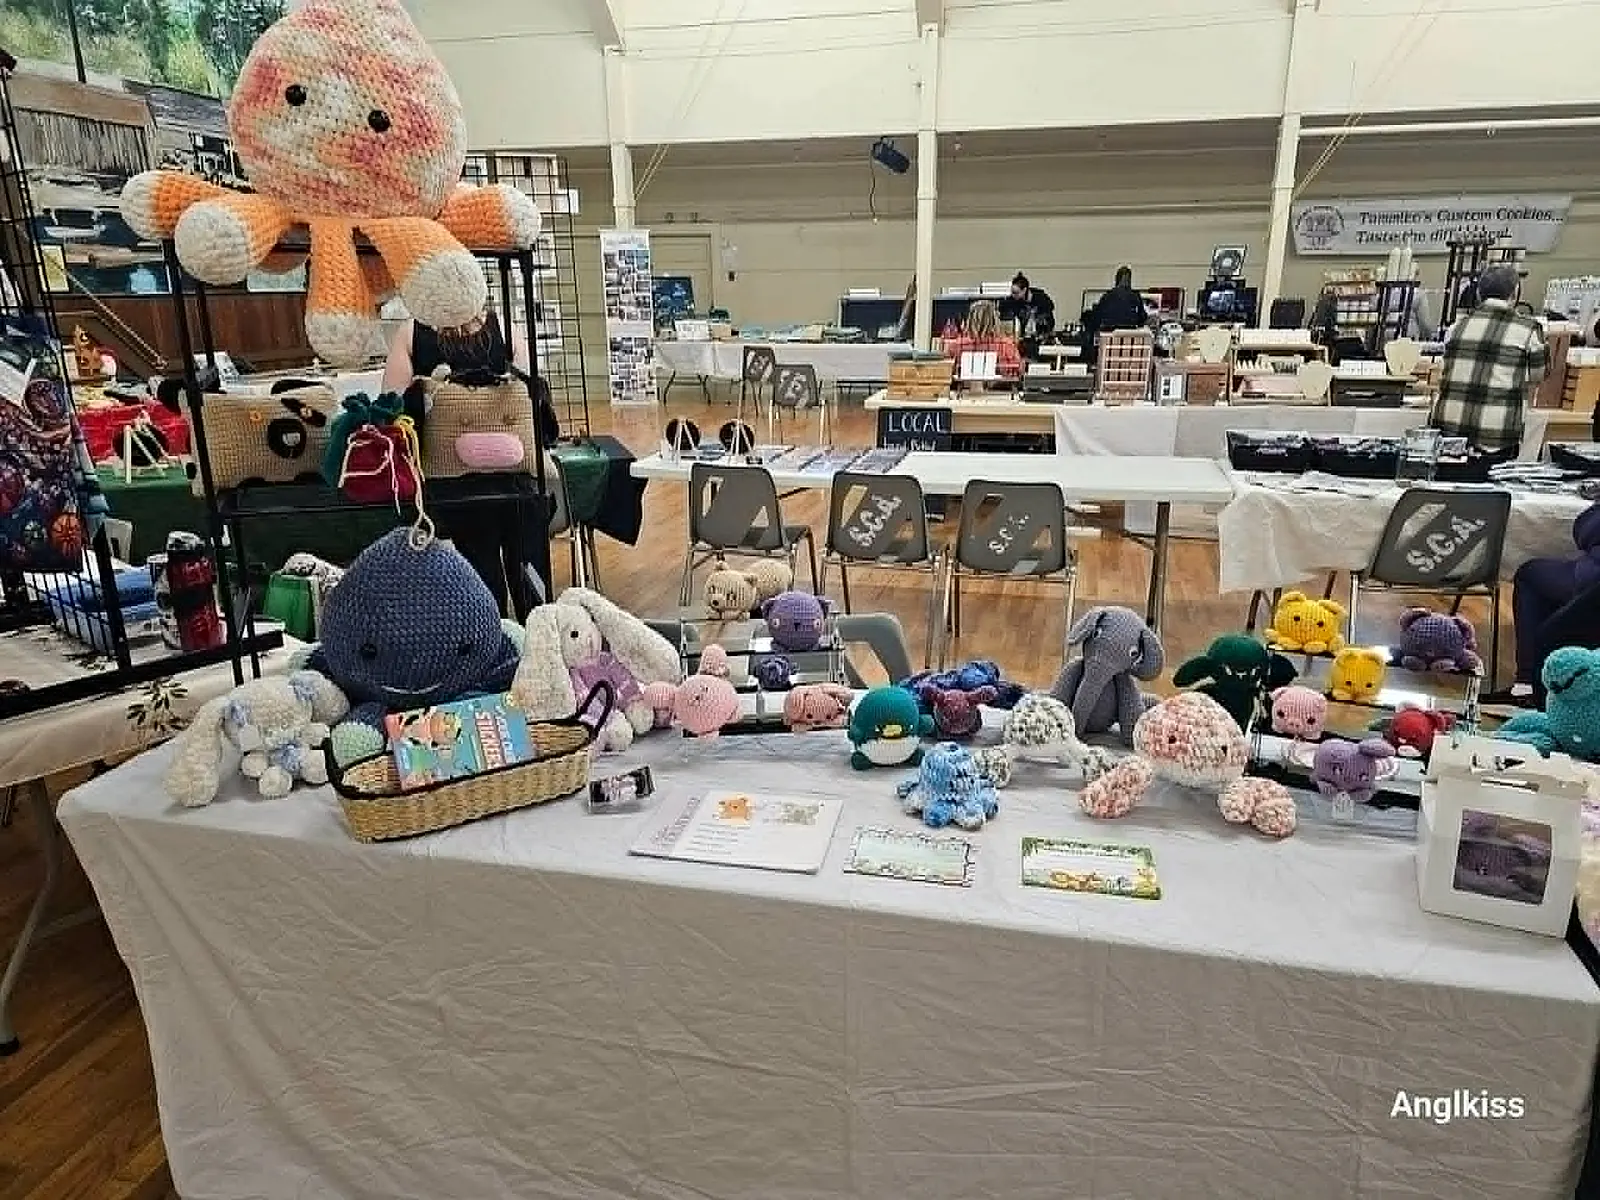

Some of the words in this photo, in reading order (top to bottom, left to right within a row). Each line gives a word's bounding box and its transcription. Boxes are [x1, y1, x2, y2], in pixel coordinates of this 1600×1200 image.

[1436, 208, 1492, 222] Custom
[888, 411, 949, 433] LOCAL
[1405, 514, 1487, 574] S.C.A.
